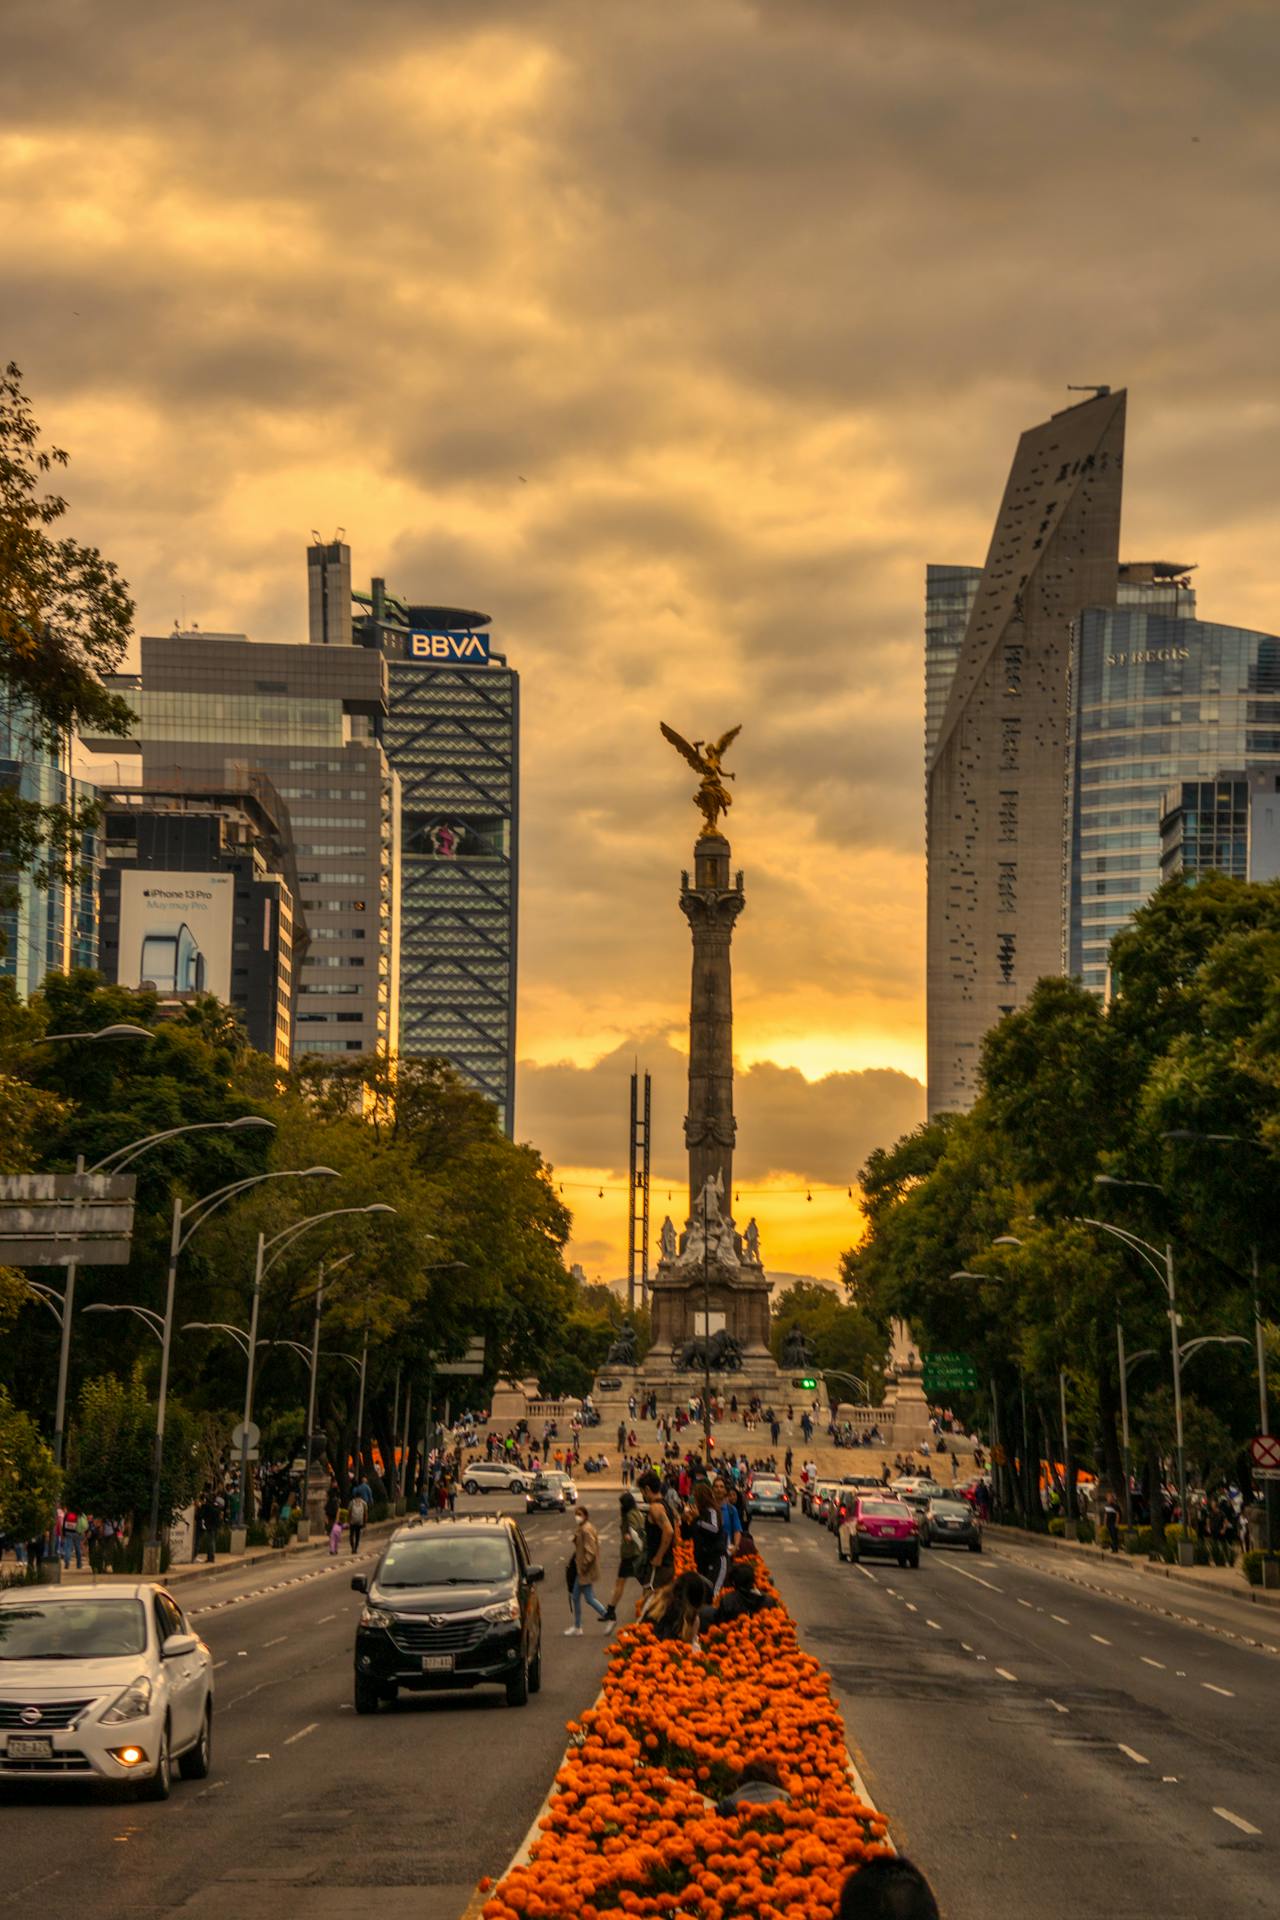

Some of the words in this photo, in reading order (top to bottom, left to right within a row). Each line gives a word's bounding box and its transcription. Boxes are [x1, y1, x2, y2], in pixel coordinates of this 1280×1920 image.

[412, 634, 487, 658] BBVA
[1131, 648, 1190, 665] REGIS
[151, 889, 183, 899] iPhone
[185, 890, 195, 898] 13
[196, 890, 212, 899] Pro
[146, 900, 167, 910] Muy
[168, 902, 189, 911] muy
